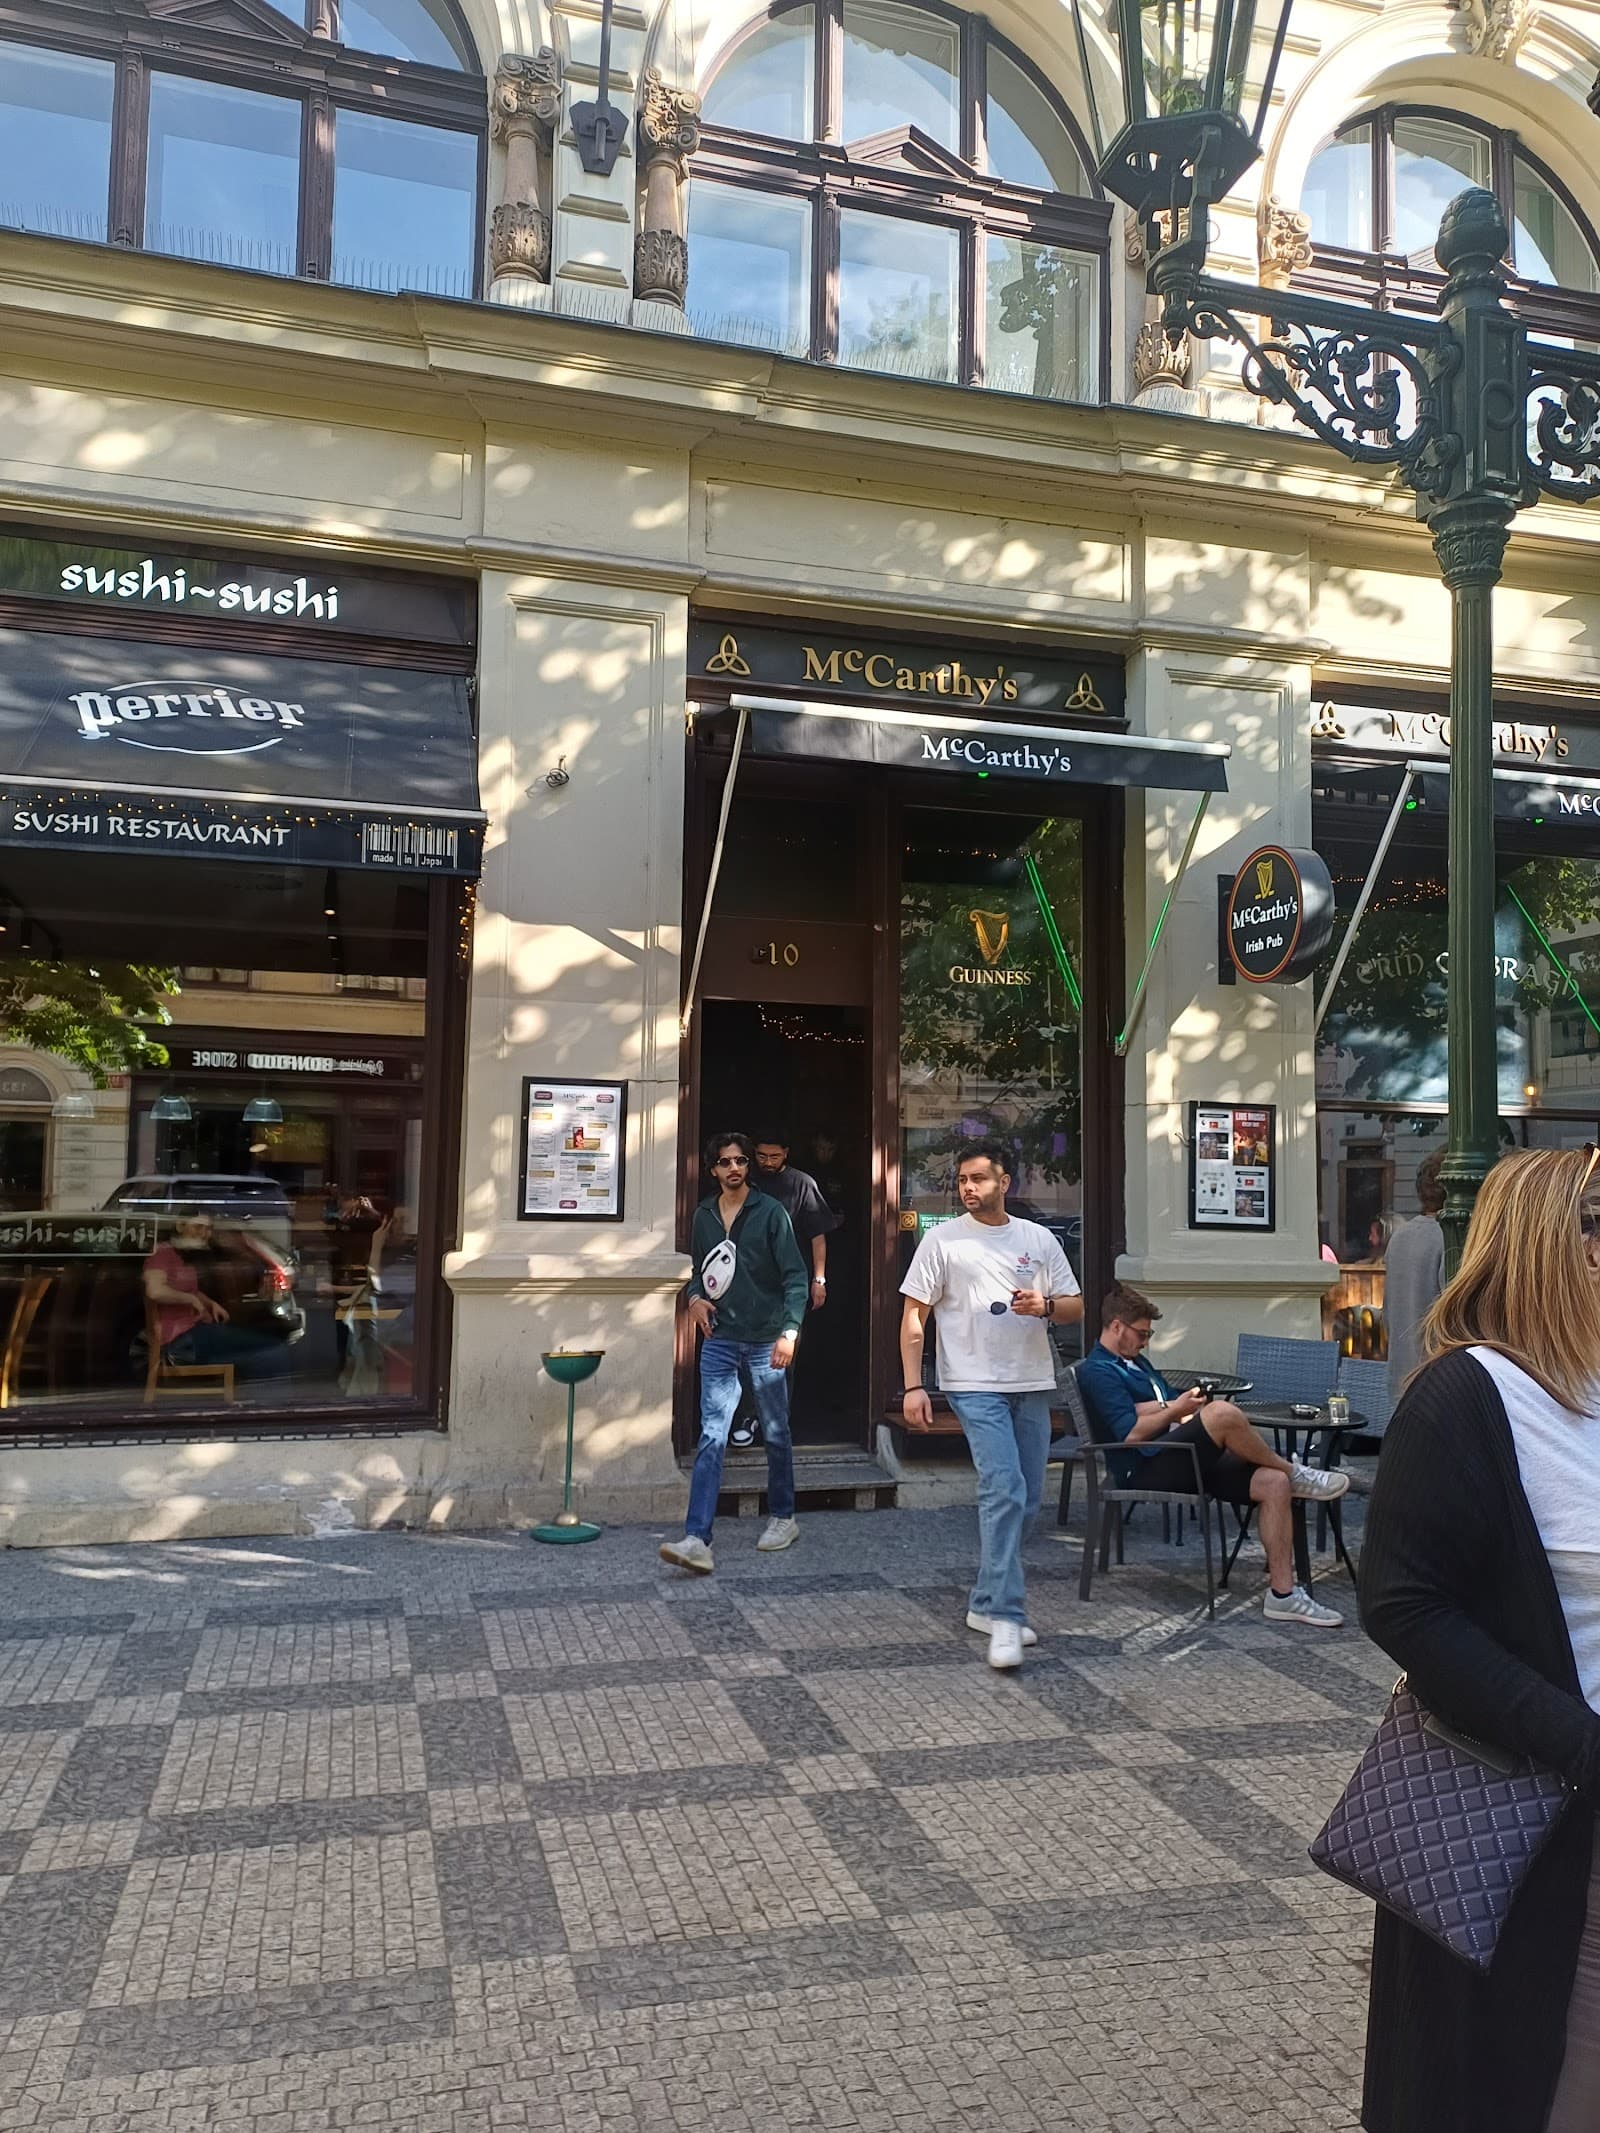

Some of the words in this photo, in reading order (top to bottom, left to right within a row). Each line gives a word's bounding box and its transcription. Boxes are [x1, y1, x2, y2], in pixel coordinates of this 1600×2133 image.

[60, 559, 339, 620] sushi~sushi
[803, 647, 1018, 705] McCarthy's
[921, 735, 1072, 775] McCarthy's
[1387, 712, 1569, 763] Mcthy's
[13, 811, 98, 834] SUSHI
[107, 816, 291, 847] RESTAURANT
[372, 853, 394, 863] made
[404, 854, 413, 865] in
[1232, 895, 1298, 930] McCarthy's
[767, 942, 799, 967] 10
[1245, 937, 1264, 954] Irish
[1266, 933, 1283, 949] Pub
[949, 965, 1032, 986] GUINNESS
